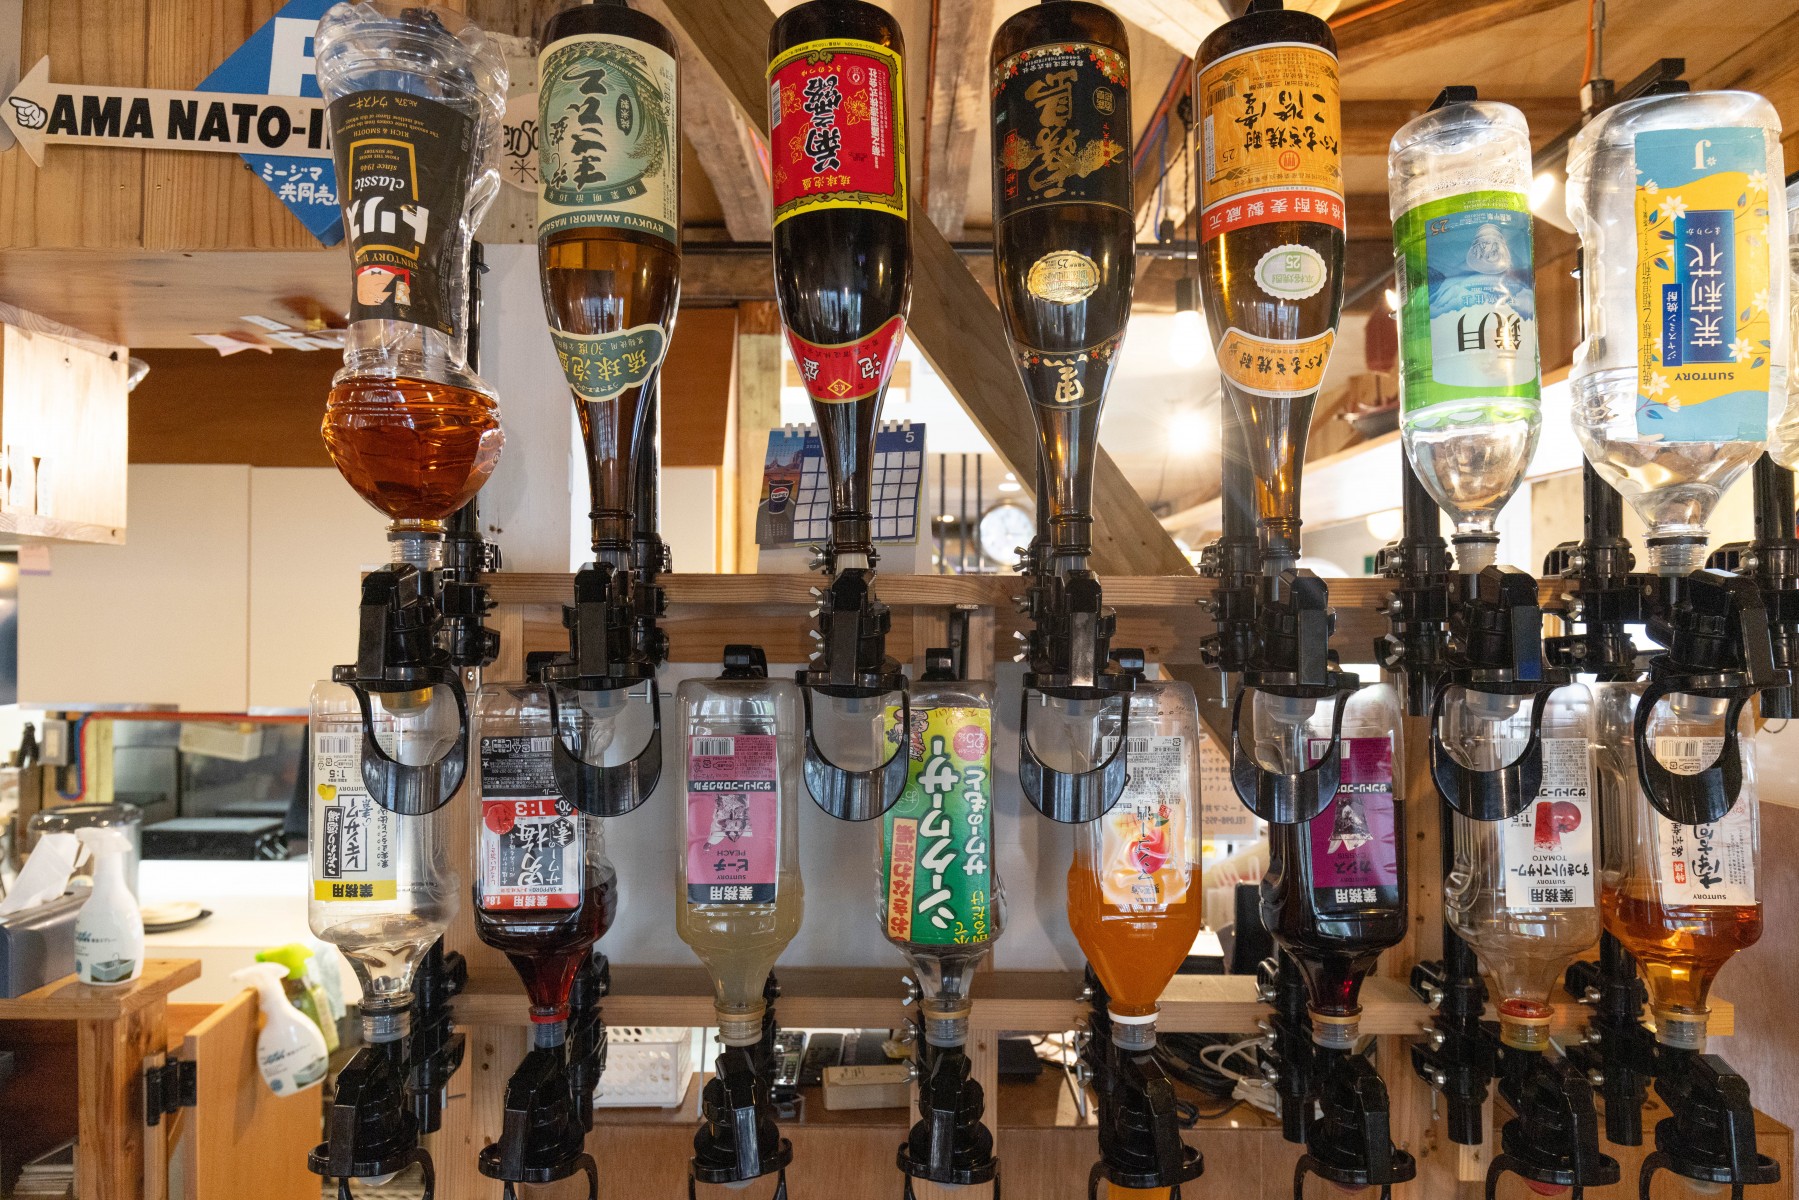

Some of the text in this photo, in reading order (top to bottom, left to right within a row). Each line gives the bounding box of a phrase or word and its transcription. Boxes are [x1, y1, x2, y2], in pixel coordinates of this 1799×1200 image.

[801, 65, 841, 76] きくのつゆ
[348, 96, 388, 109] ウイスキー
[1234, 90, 1326, 129] 二階堂
[46, 94, 332, 149] AMA NATO-I
[802, 75, 842, 174] 菊之露
[353, 128, 381, 137] SMOOTH
[390, 129, 409, 138] RICH
[1222, 148, 1235, 162] 25
[1692, 139, 1711, 170] J
[262, 162, 323, 182] ミージマ
[377, 163, 398, 171] since
[354, 176, 405, 192] classic
[801, 174, 851, 190] 琉球泡盛
[279, 182, 340, 205] 共同売
[570, 213, 621, 224] AWAMORI
[1210, 197, 1345, 230] 格焼酎麦製蔵元
[624, 216, 664, 234] RYUKYU
[1431, 219, 1449, 235] 25
[1686, 227, 1720, 235] まつりか
[371, 253, 419, 269] SUNTORY
[1057, 258, 1069, 269] 25
[1286, 254, 1301, 269] 25
[1684, 242, 1726, 347] 茉莉花
[1457, 312, 1521, 352] 鏡月
[1666, 290, 1679, 360] ジャスミン焼酎
[1043, 353, 1089, 403] 黒
[1674, 371, 1734, 381] SUNTORY
[905, 431, 915, 444] 5
[329, 770, 345, 778] 1:5
[693, 781, 771, 790] サントリープロカクテル
[1337, 784, 1387, 793] サントリープロ
[515, 801, 546, 816] 1:3
[962, 769, 988, 876] サワーのもと
[344, 797, 361, 869] レモンサワー
[552, 821, 572, 846] 素
[918, 735, 959, 929] シークワーサー
[325, 809, 341, 875] こだわり酒場
[515, 823, 550, 887] 男梅
[546, 841, 561, 885] サワーの
[713, 858, 749, 872] ピーチ
[1333, 860, 1372, 874] カシス
[1510, 863, 1590, 876] すっきりトマトサワー
[332, 883, 374, 898] 業務用
[709, 886, 754, 901] 業務用
[1335, 888, 1377, 903] 業務用
[1530, 889, 1574, 903] 業務用
[513, 896, 548, 907] 業務用
